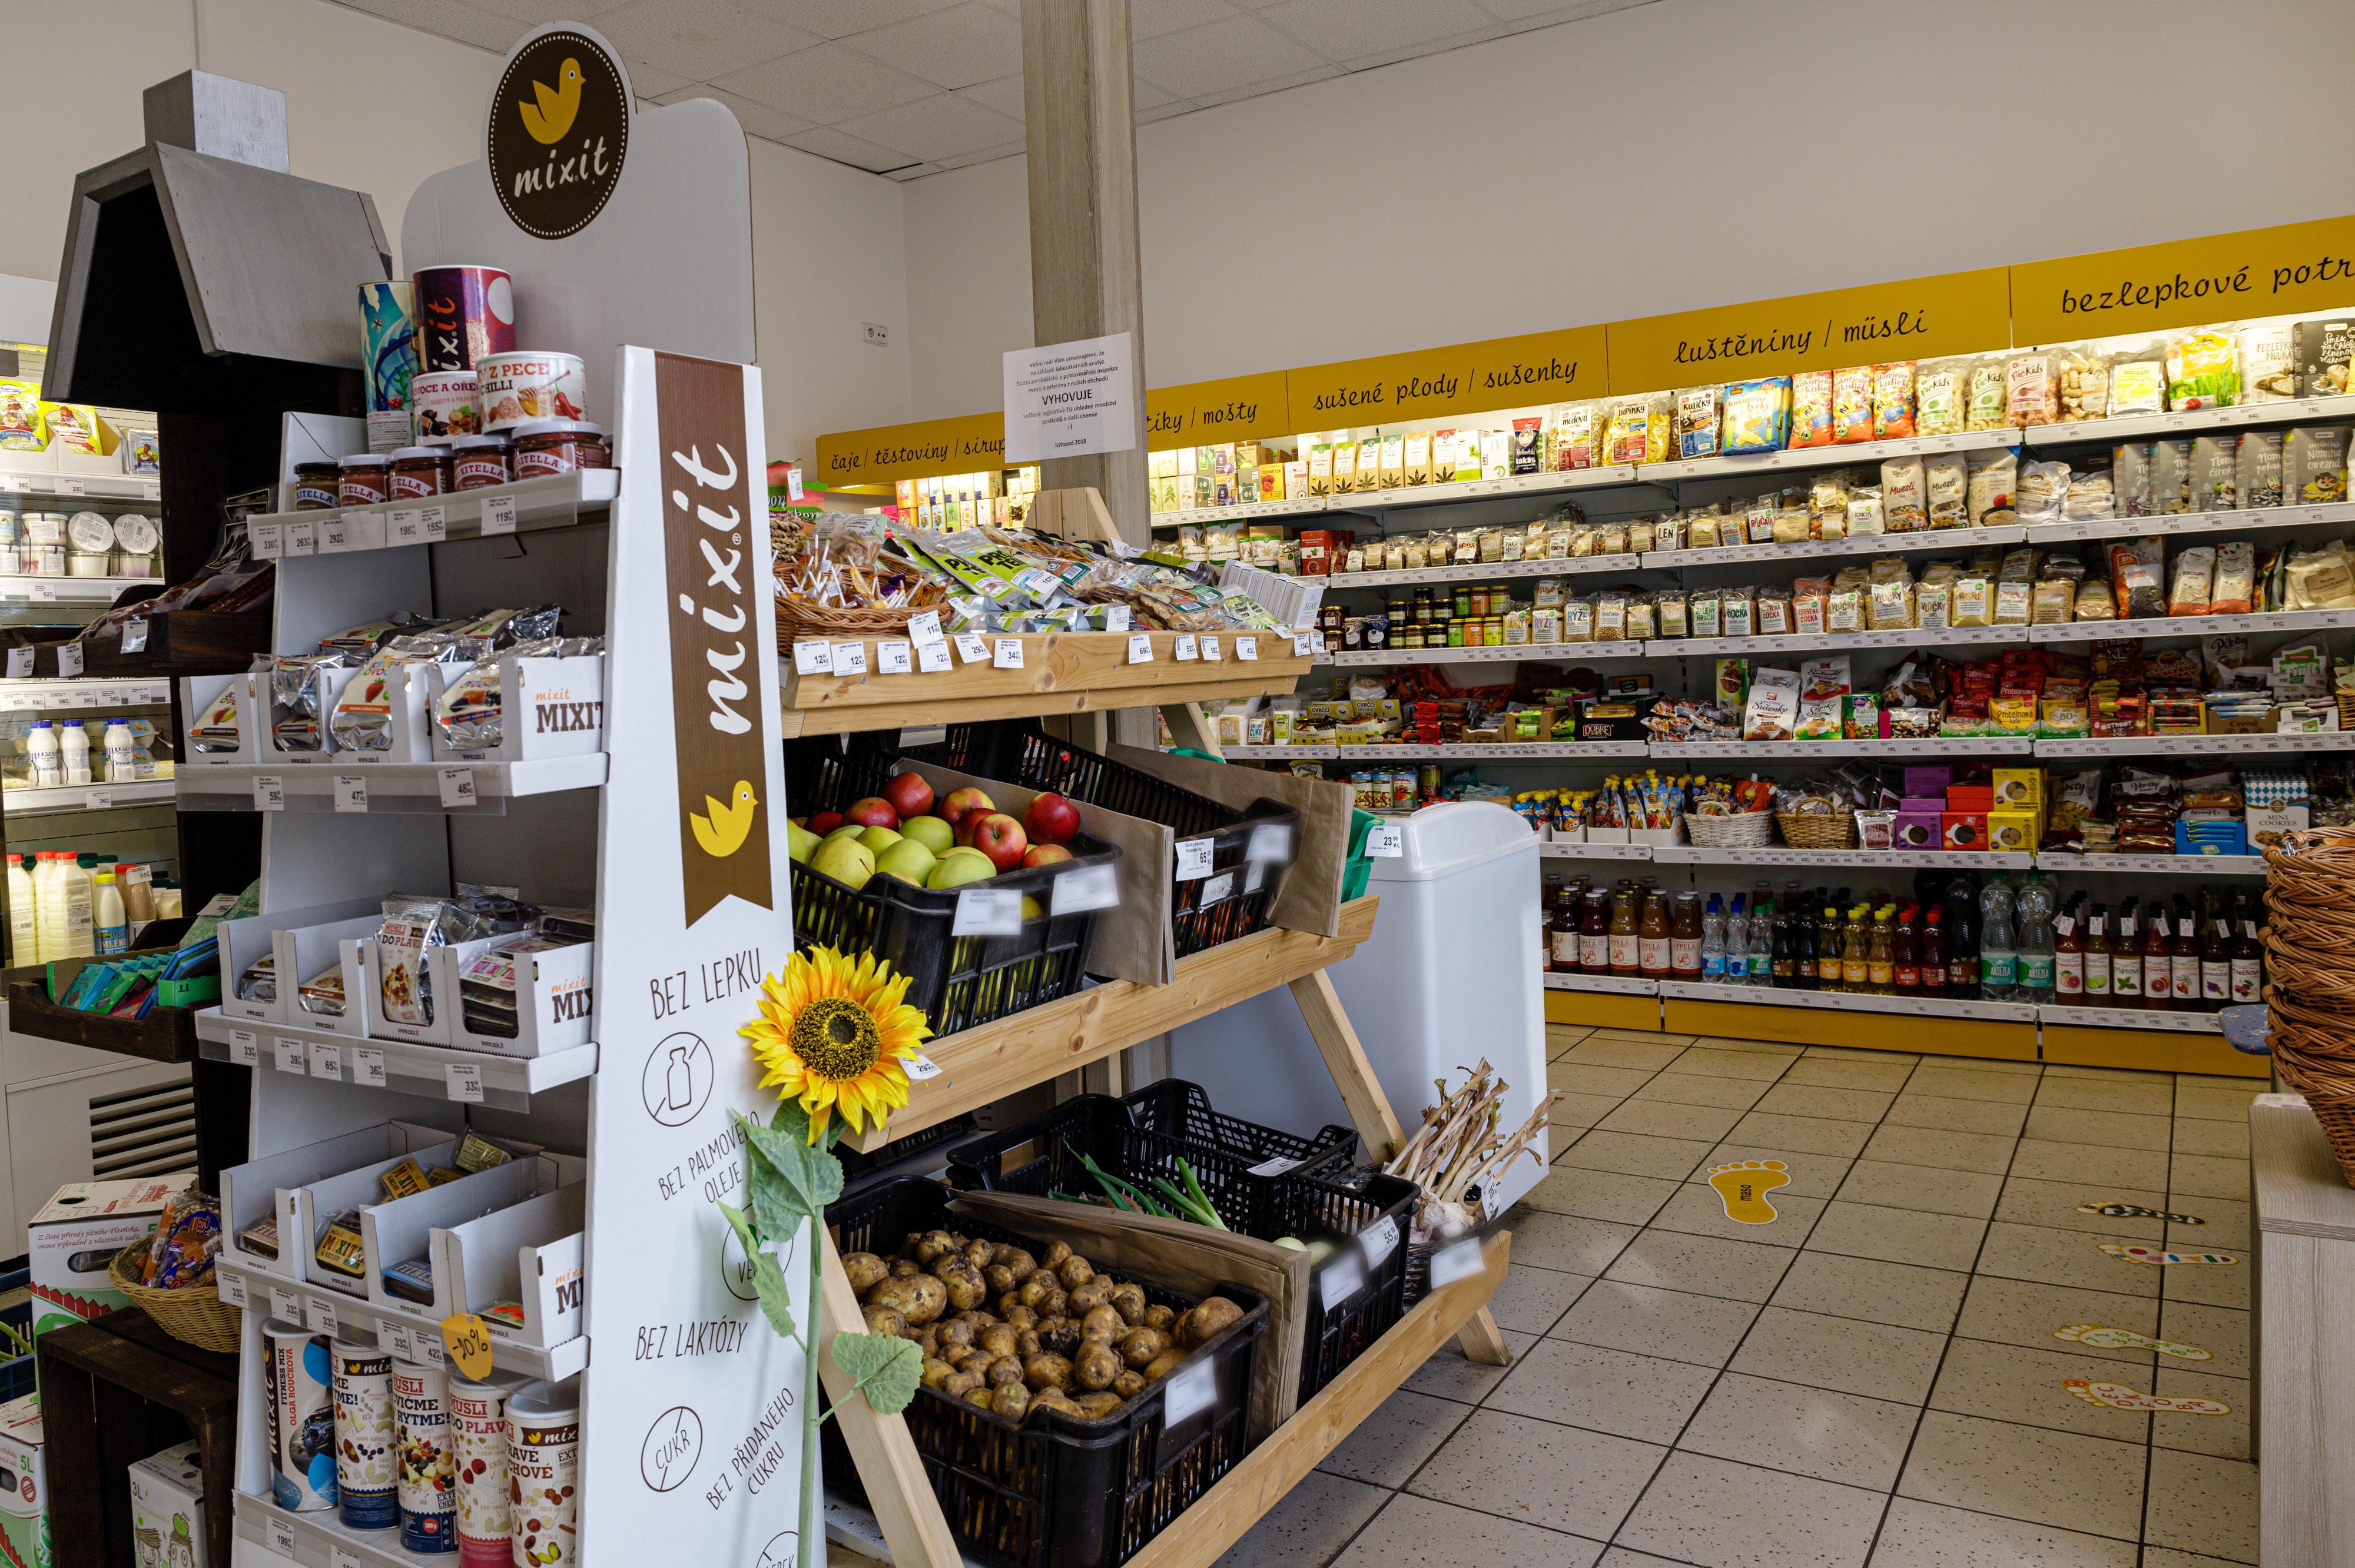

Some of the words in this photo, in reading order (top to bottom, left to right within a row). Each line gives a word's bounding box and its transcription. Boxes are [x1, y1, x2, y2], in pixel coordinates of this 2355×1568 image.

[2062, 265, 2252, 314] bezlepkové
[1674, 330, 1812, 364] luštěniny
[1845, 310, 1928, 341] müsli
[1066, 351, 1098, 361] oznamujeme,
[489, 366, 498, 378] Z
[503, 363, 549, 376] PECE
[1037, 366, 1054, 374] základě
[1056, 362, 1087, 371] laboratorních
[1031, 374, 1058, 384] zemědělské
[1063, 369, 1096, 380] potravinářské
[1097, 366, 1118, 375] inspekce
[442, 384, 449, 393] A
[1047, 382, 1066, 390] zelenina
[1087, 376, 1108, 384] obchodů
[1314, 383, 1383, 411] sušené
[1397, 373, 1458, 405] plody
[1484, 358, 1578, 389] sušenky
[1042, 389, 1092, 405] VYHOVUJE
[1042, 407, 1065, 417] legislativě
[1094, 400, 1116, 408] množství
[1202, 401, 1258, 427] mošty
[1042, 416, 1063, 425] pesticidů
[1055, 439, 1074, 447] listopad
[831, 448, 860, 471] čaje
[874, 443, 948, 466] těstoviny
[1890, 480, 1915, 495] Muesli
[1932, 478, 1956, 490] Muesli
[495, 512, 508, 523] 119
[399, 526, 411, 536] 198
[427, 522, 438, 533] 155
[329, 534, 340, 543] 292
[1658, 528, 1674, 540] LEN
[264, 540, 274, 549] 330
[296, 538, 307, 547] 263
[1304, 602, 1316, 611] AGAR
[1832, 600, 1855, 611] VLOČKY
[1921, 600, 1946, 612] VLOČKY
[1567, 608, 1588, 622] RÝŽE
[1727, 609, 1747, 618] ČOČKA
[1800, 614, 1818, 623] ČOČKA
[927, 625, 934, 634] 11
[815, 655, 822, 664] 12
[851, 656, 859, 665] 12
[457, 783, 467, 794] 48
[269, 791, 278, 802] 59
[351, 790, 360, 802] 47
[1384, 837, 1392, 845] 23
[1200, 852, 1206, 863] 65
[383, 935, 393, 944] DO
[1673, 942, 1696, 951] APPELA
[650, 971, 690, 1019] BEZ
[702, 948, 761, 1002] LEPKU
[243, 1046, 253, 1057] 33
[290, 1055, 298, 1065] 39
[325, 1061, 334, 1071] 65
[369, 1064, 379, 1076] 36
[465, 1081, 475, 1092] 33
[658, 1167, 685, 1201] BEZ
[705, 1161, 742, 1203] OLEJE
[1740, 1182, 1752, 1201] maso
[86, 1229, 108, 1237] jižního
[110, 1225, 140, 1234] Plzeňska,
[58, 1240, 87, 1249] výhradně
[95, 1235, 123, 1244] vlastních
[1384, 1231, 1393, 1244] 55
[394, 1338, 403, 1348] 33
[636, 1326, 668, 1361] BEZ
[676, 1315, 748, 1357] LAKTÓZY
[428, 1348, 436, 1358] 42
[278, 1370, 287, 1406] FITNESS
[397, 1411, 450, 1426] RYTME!
[656, 1429, 690, 1469] CUKR
[706, 1473, 733, 1510] BEZ
[732, 1387, 794, 1477] PŘIDANÉHO
[21, 1454, 34, 1473] 5L
[748, 1441, 784, 1495] CUKRU
[132, 1482, 142, 1500] 3L
[277, 1534, 288, 1546] 199
